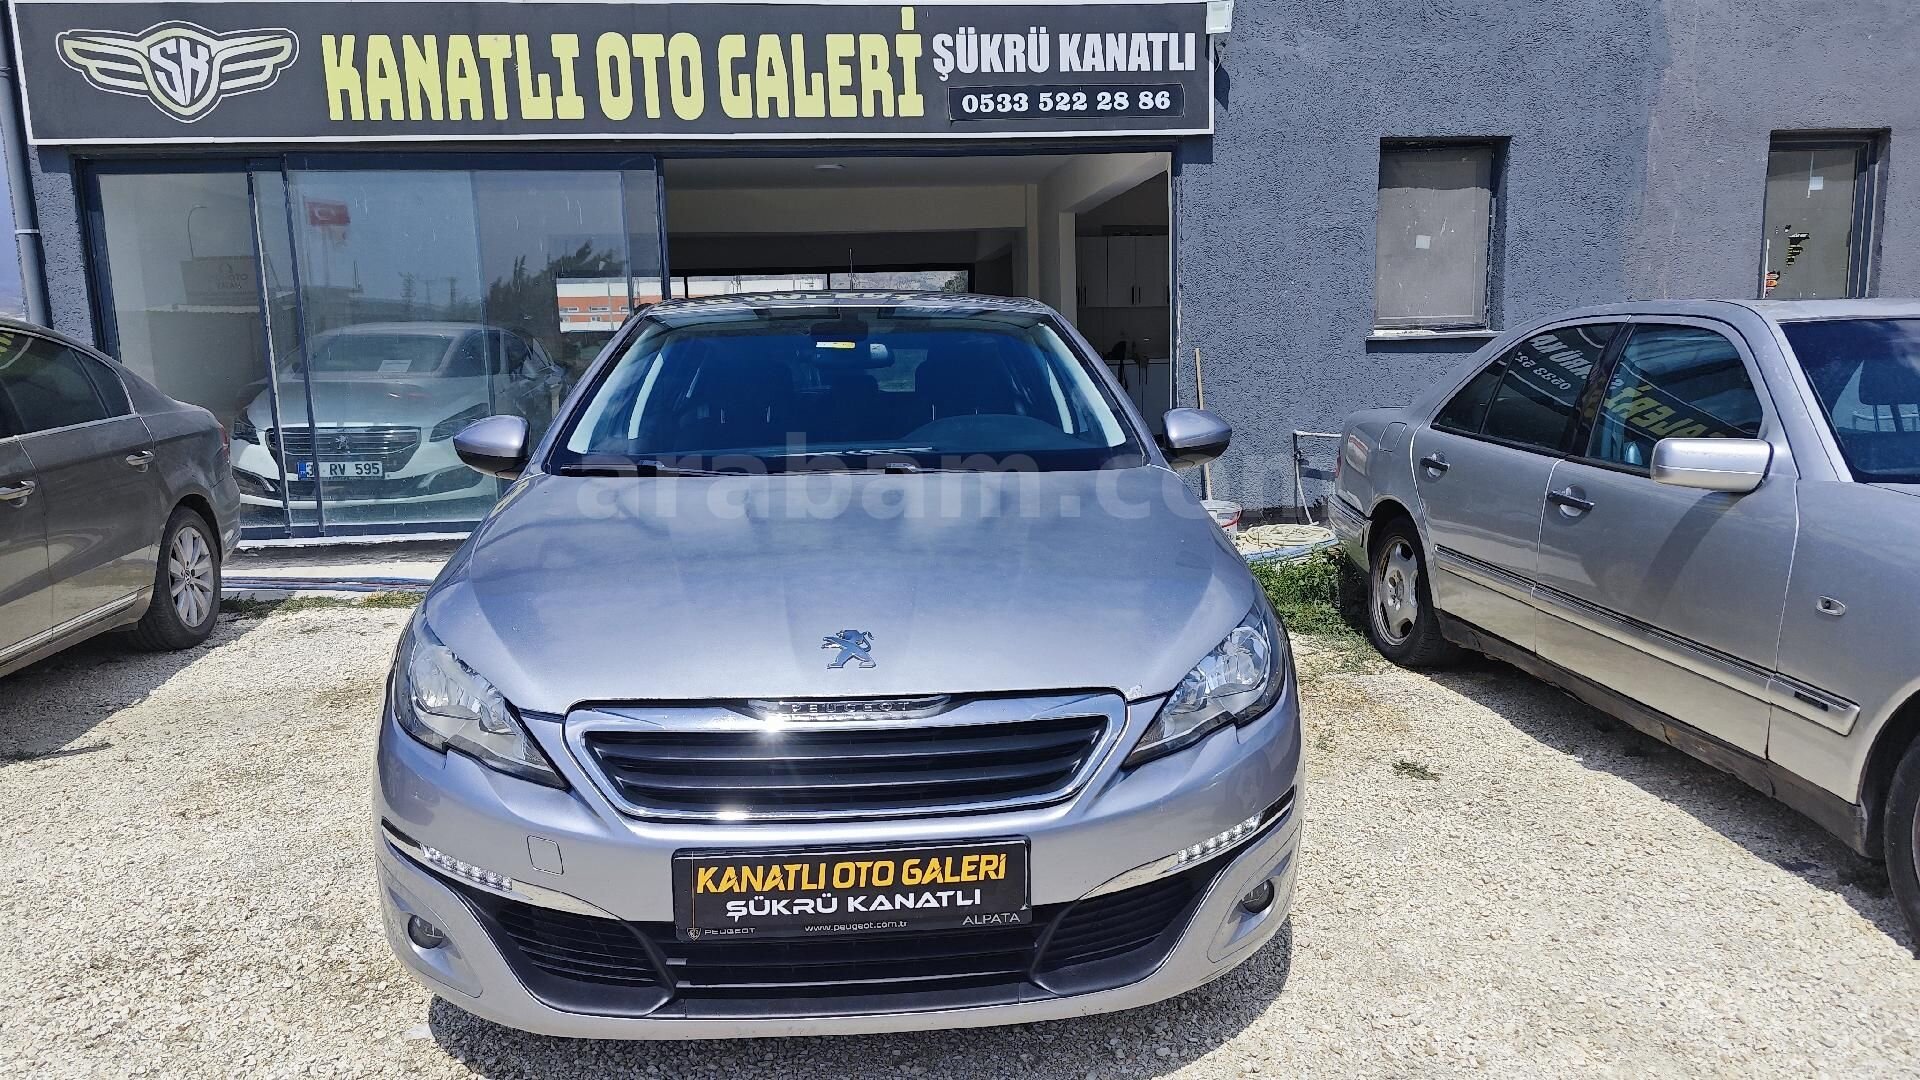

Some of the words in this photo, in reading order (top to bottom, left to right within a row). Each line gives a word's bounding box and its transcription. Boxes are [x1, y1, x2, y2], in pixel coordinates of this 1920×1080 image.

[321, 33, 585, 121] KANATLI
[595, 31, 705, 121] OTO
[717, 6, 925, 119] GALERİ
[932, 26, 1048, 81] ŞÜKRÜ
[1058, 32, 1196, 73] KANATLI
[961, 93, 1029, 114] 0533
[1038, 92, 1088, 112] 522
[1096, 92, 1130, 111] 28
[1138, 90, 1171, 110] 86
[329, 463, 346, 475] RV
[355, 463, 380, 475] 595
[791, 702, 910, 713] PEUGEOT
[696, 862, 827, 894] KANATLI
[832, 860, 895, 889] OTO
[725, 893, 838, 923] ŞÜKRÜ
[847, 889, 981, 912] KANATLI
[804, 919, 908, 932] www.peugeot.com.tr
[962, 912, 1021, 926] ALPATA
